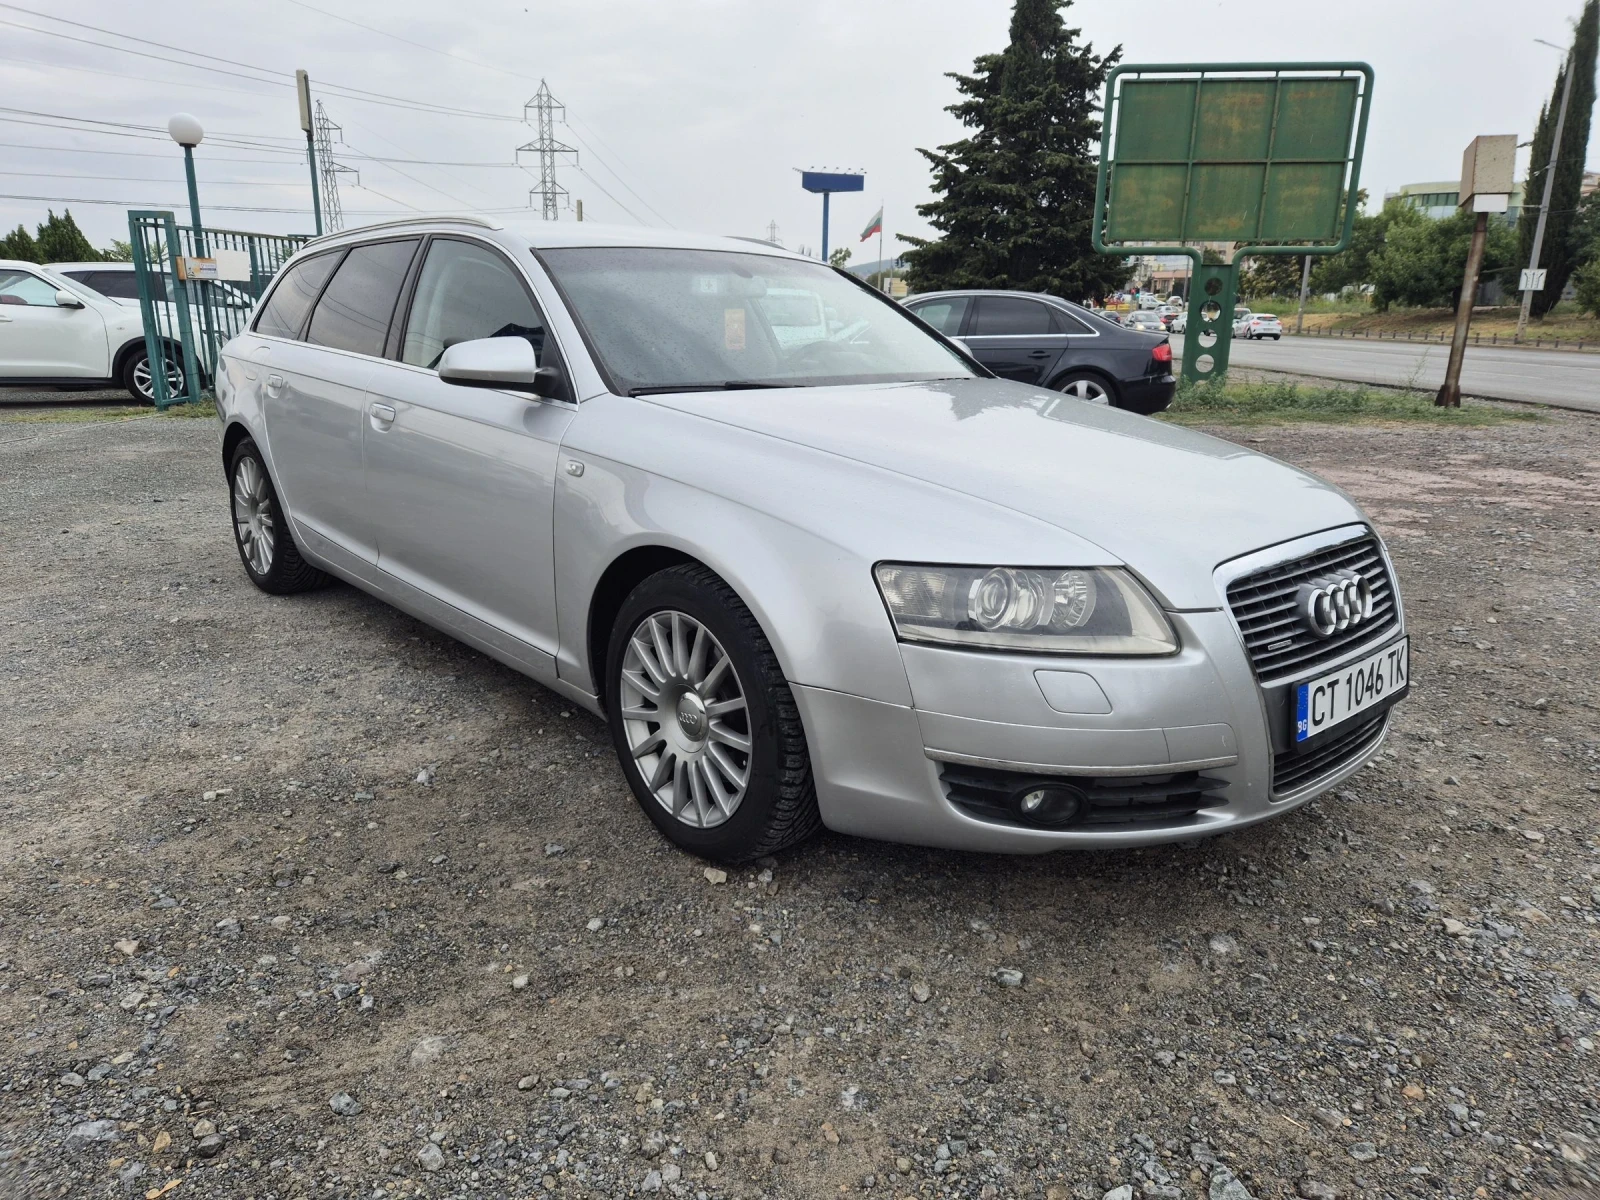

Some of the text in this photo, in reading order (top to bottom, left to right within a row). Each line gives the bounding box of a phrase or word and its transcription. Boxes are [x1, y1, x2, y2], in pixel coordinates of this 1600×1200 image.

[1312, 645, 1405, 727] CT 1046 TK
[1297, 719, 1308, 733] BG
